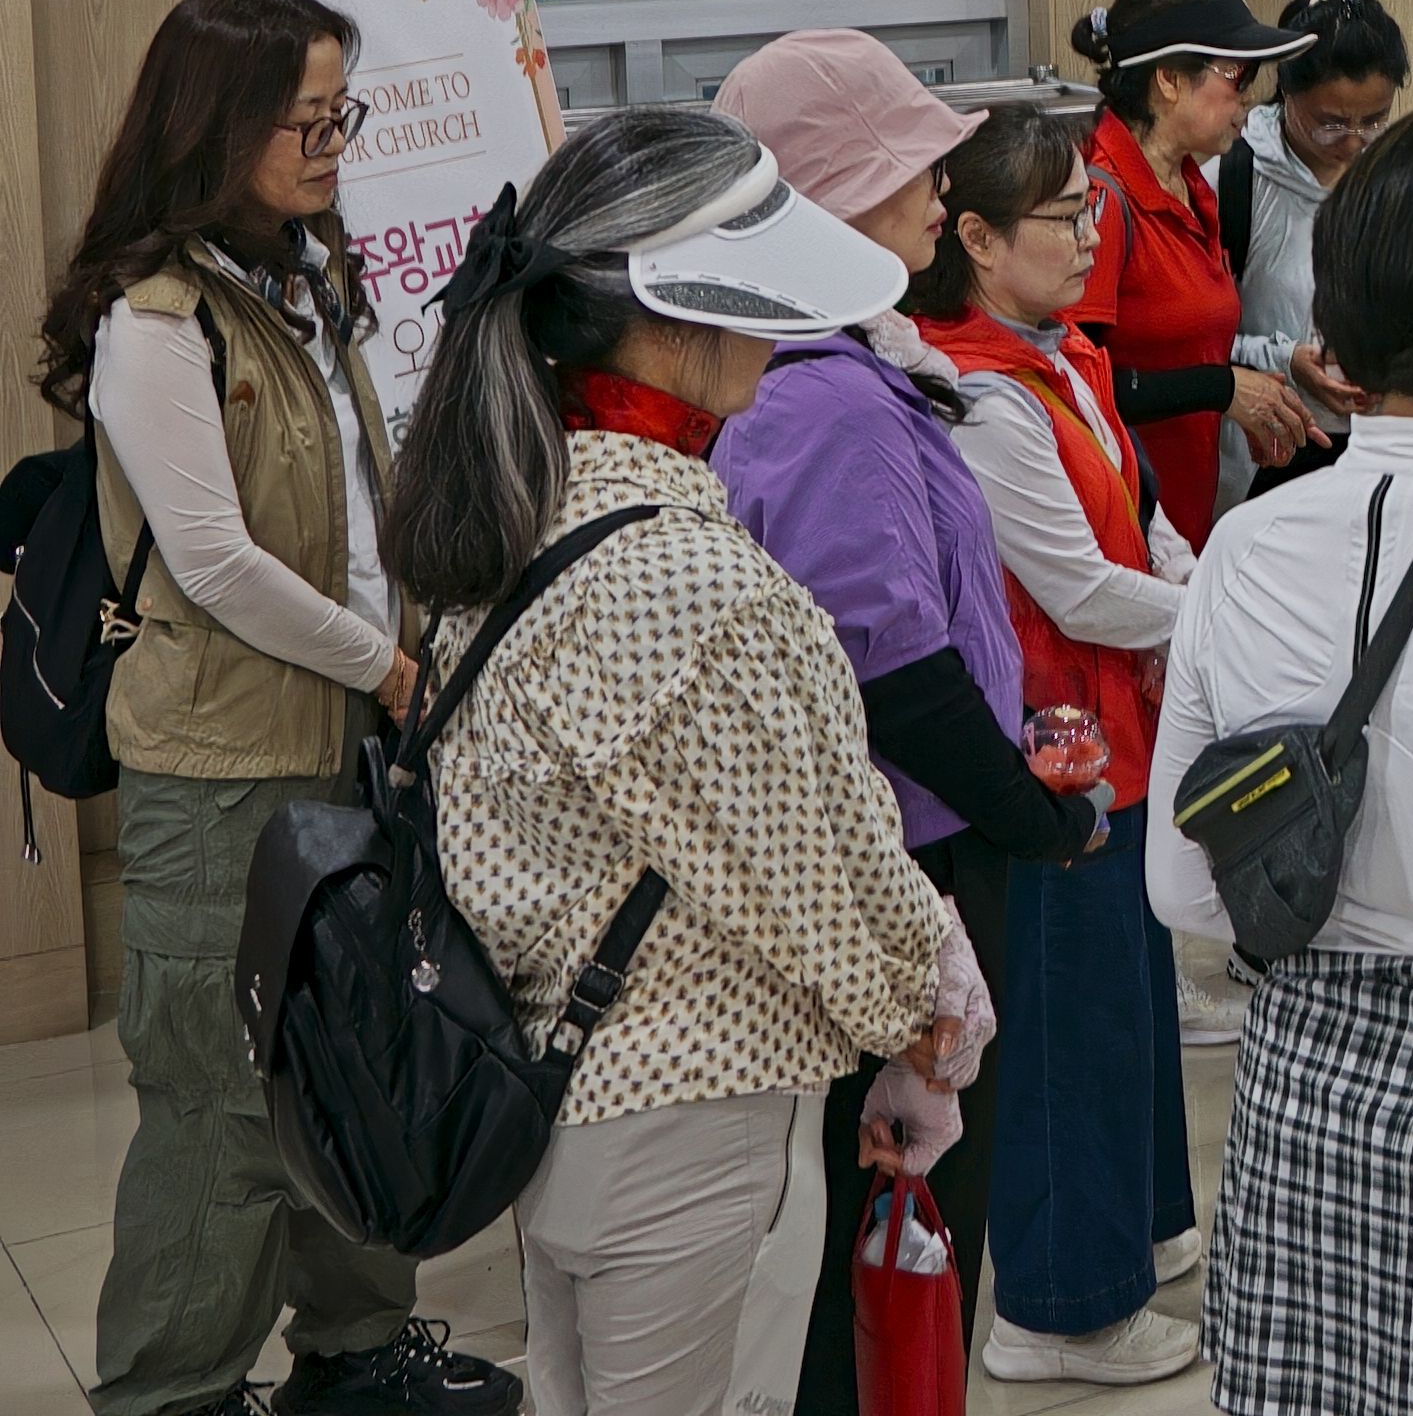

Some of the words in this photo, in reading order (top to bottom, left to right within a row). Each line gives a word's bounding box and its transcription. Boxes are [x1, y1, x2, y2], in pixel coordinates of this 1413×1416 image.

[354, 77, 434, 118] COME
[435, 70, 470, 103] TO
[340, 132, 373, 165] UR
[375, 109, 482, 157] CHURCH
[348, 205, 487, 303] 주왕교
